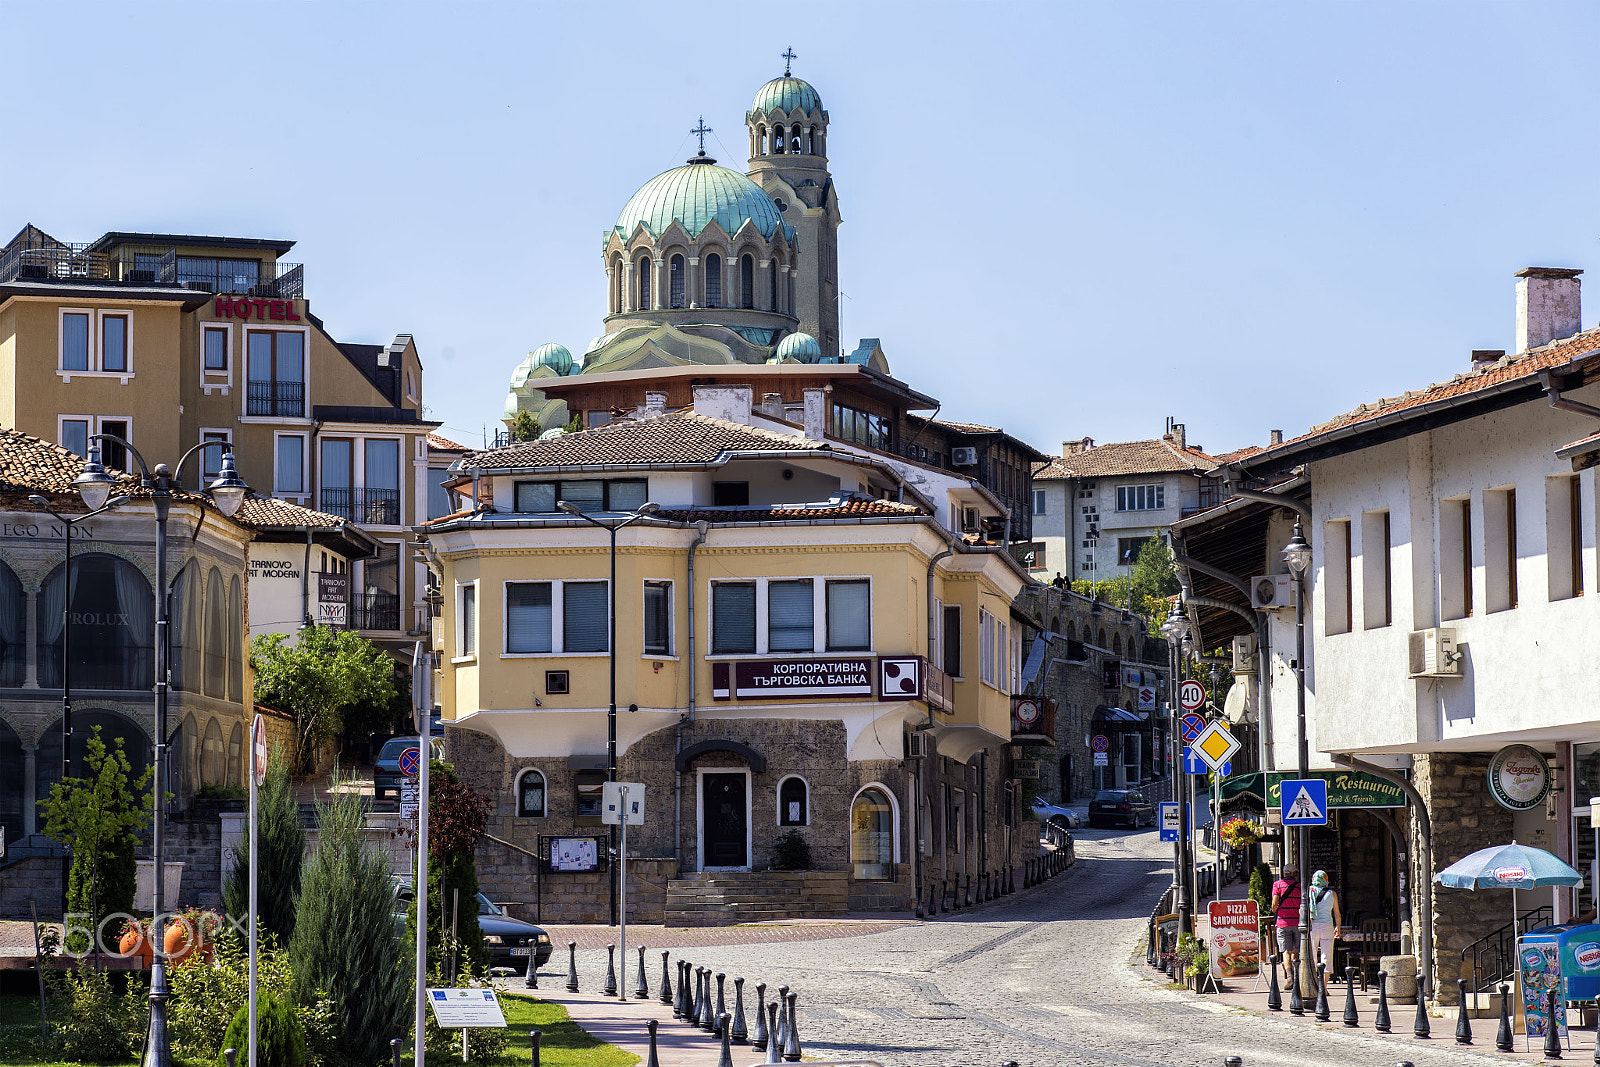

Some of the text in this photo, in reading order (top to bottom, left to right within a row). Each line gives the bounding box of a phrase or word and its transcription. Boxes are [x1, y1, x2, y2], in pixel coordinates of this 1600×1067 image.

[216, 298, 300, 320] HOTEL
[3, 523, 93, 538] EGO NON
[251, 561, 292, 569] TARNOVO
[263, 570, 299, 578] MODERN
[773, 663, 867, 674] КОРПОРАТИВНА
[753, 674, 867, 686] ТЪРГОВСКА БАНКА
[1182, 688, 1199, 702] 40
[1336, 775, 1401, 797] Restaurant
[1327, 794, 1375, 803] Food & Friends
[1227, 904, 1247, 914] PIZZA
[1213, 915, 1256, 925] SANDWICHES
